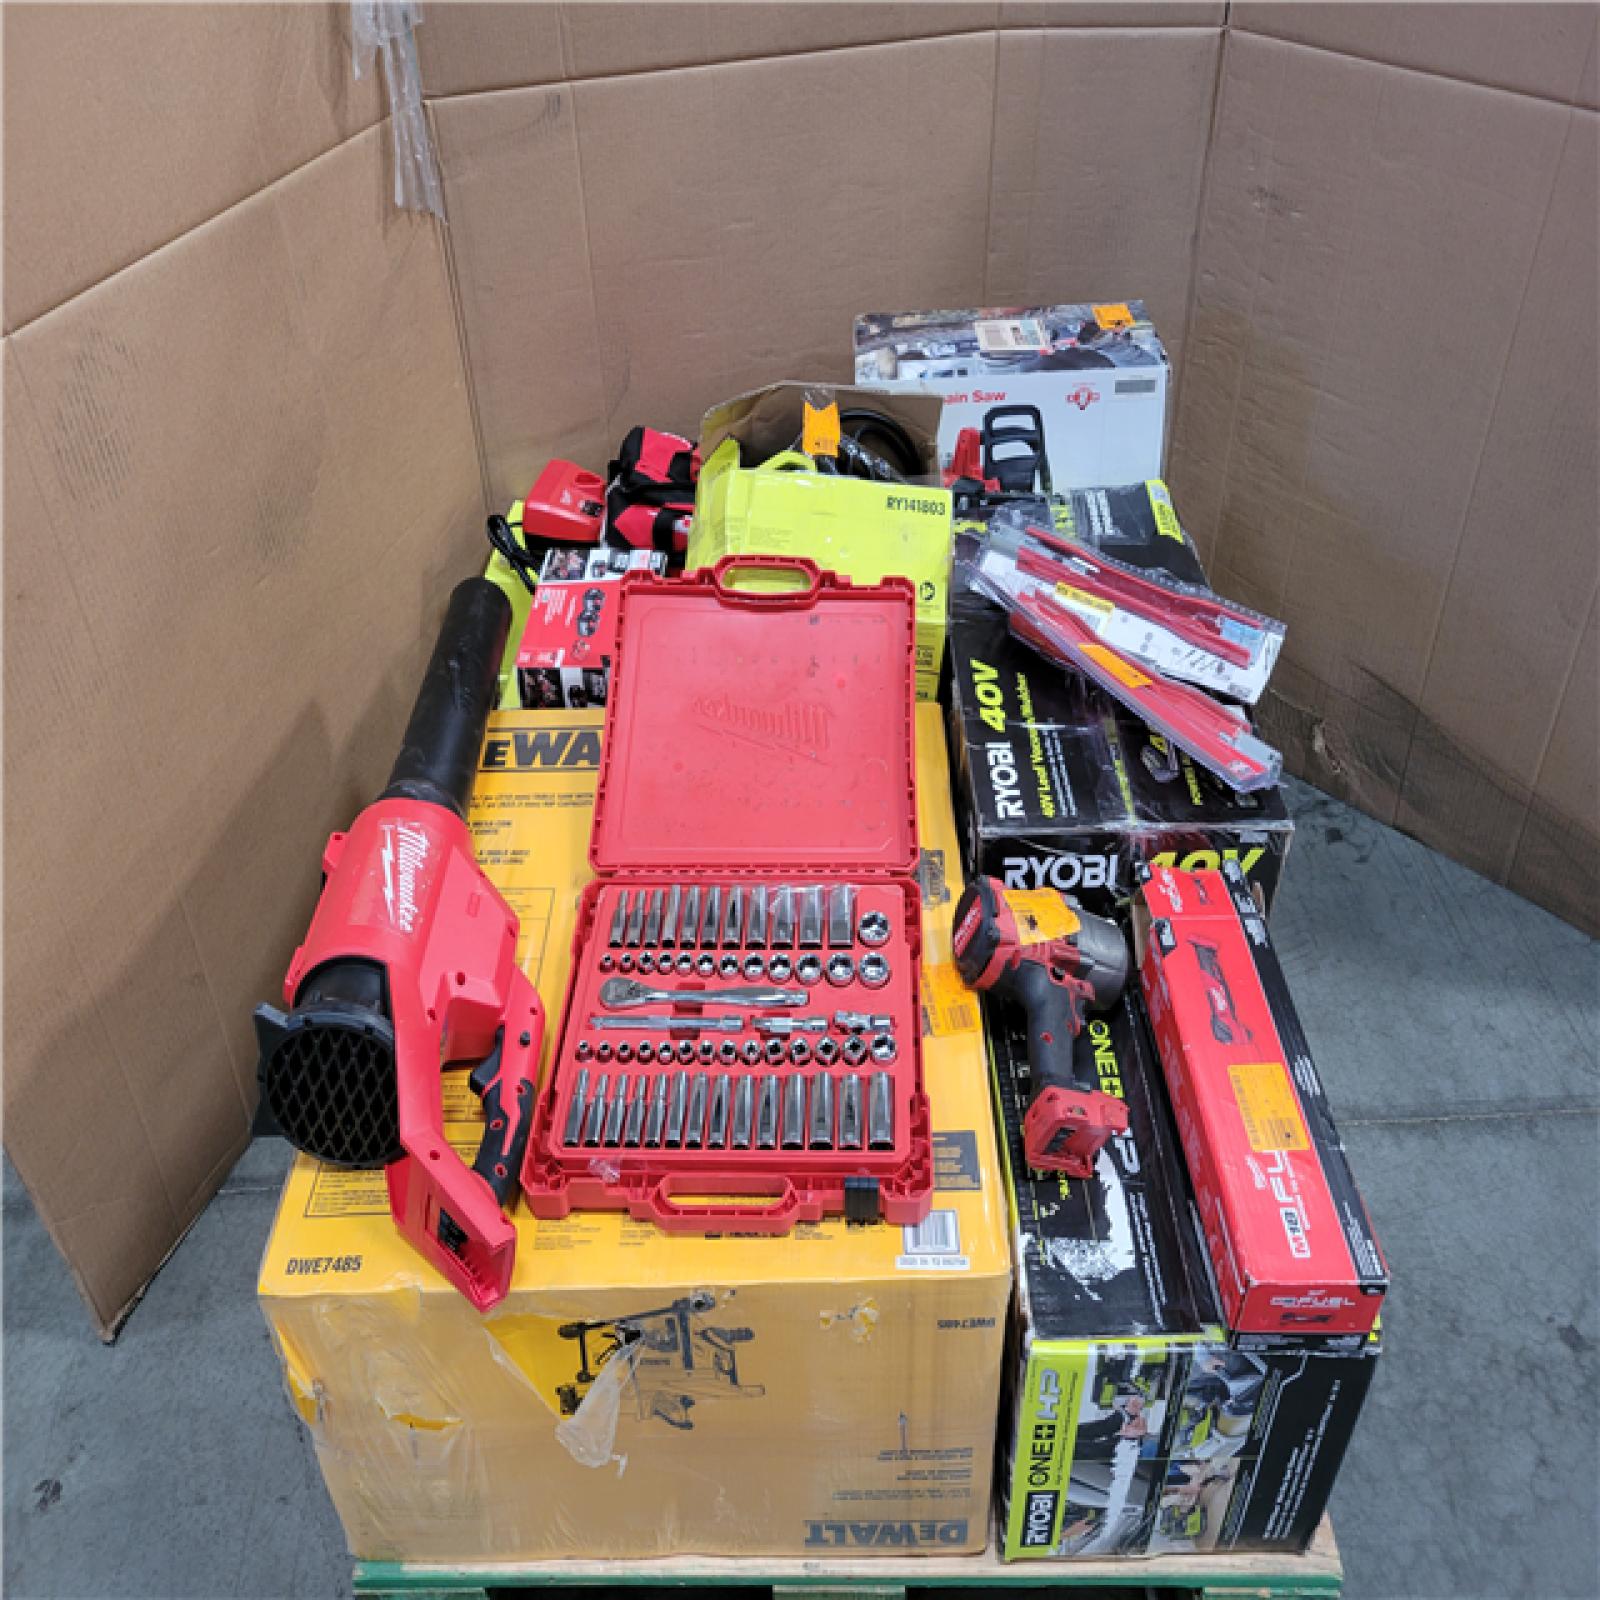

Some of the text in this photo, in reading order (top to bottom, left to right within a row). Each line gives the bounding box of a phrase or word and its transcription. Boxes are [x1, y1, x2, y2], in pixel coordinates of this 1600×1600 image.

[944, 390, 1006, 405] ain Saw
[886, 496, 946, 516] RY141803
[484, 732, 600, 766] EWA
[970, 658, 1025, 820] RYOBI 40V
[397, 821, 430, 932] Milwaukee
[1002, 854, 1119, 890] RYOBI
[1264, 1150, 1295, 1203] FU
[285, 1255, 363, 1276] DWE7485
[1037, 1370, 1062, 1420] HP
[804, 1520, 968, 1546] DEWALT
[1026, 1494, 1054, 1545] RYOBI
